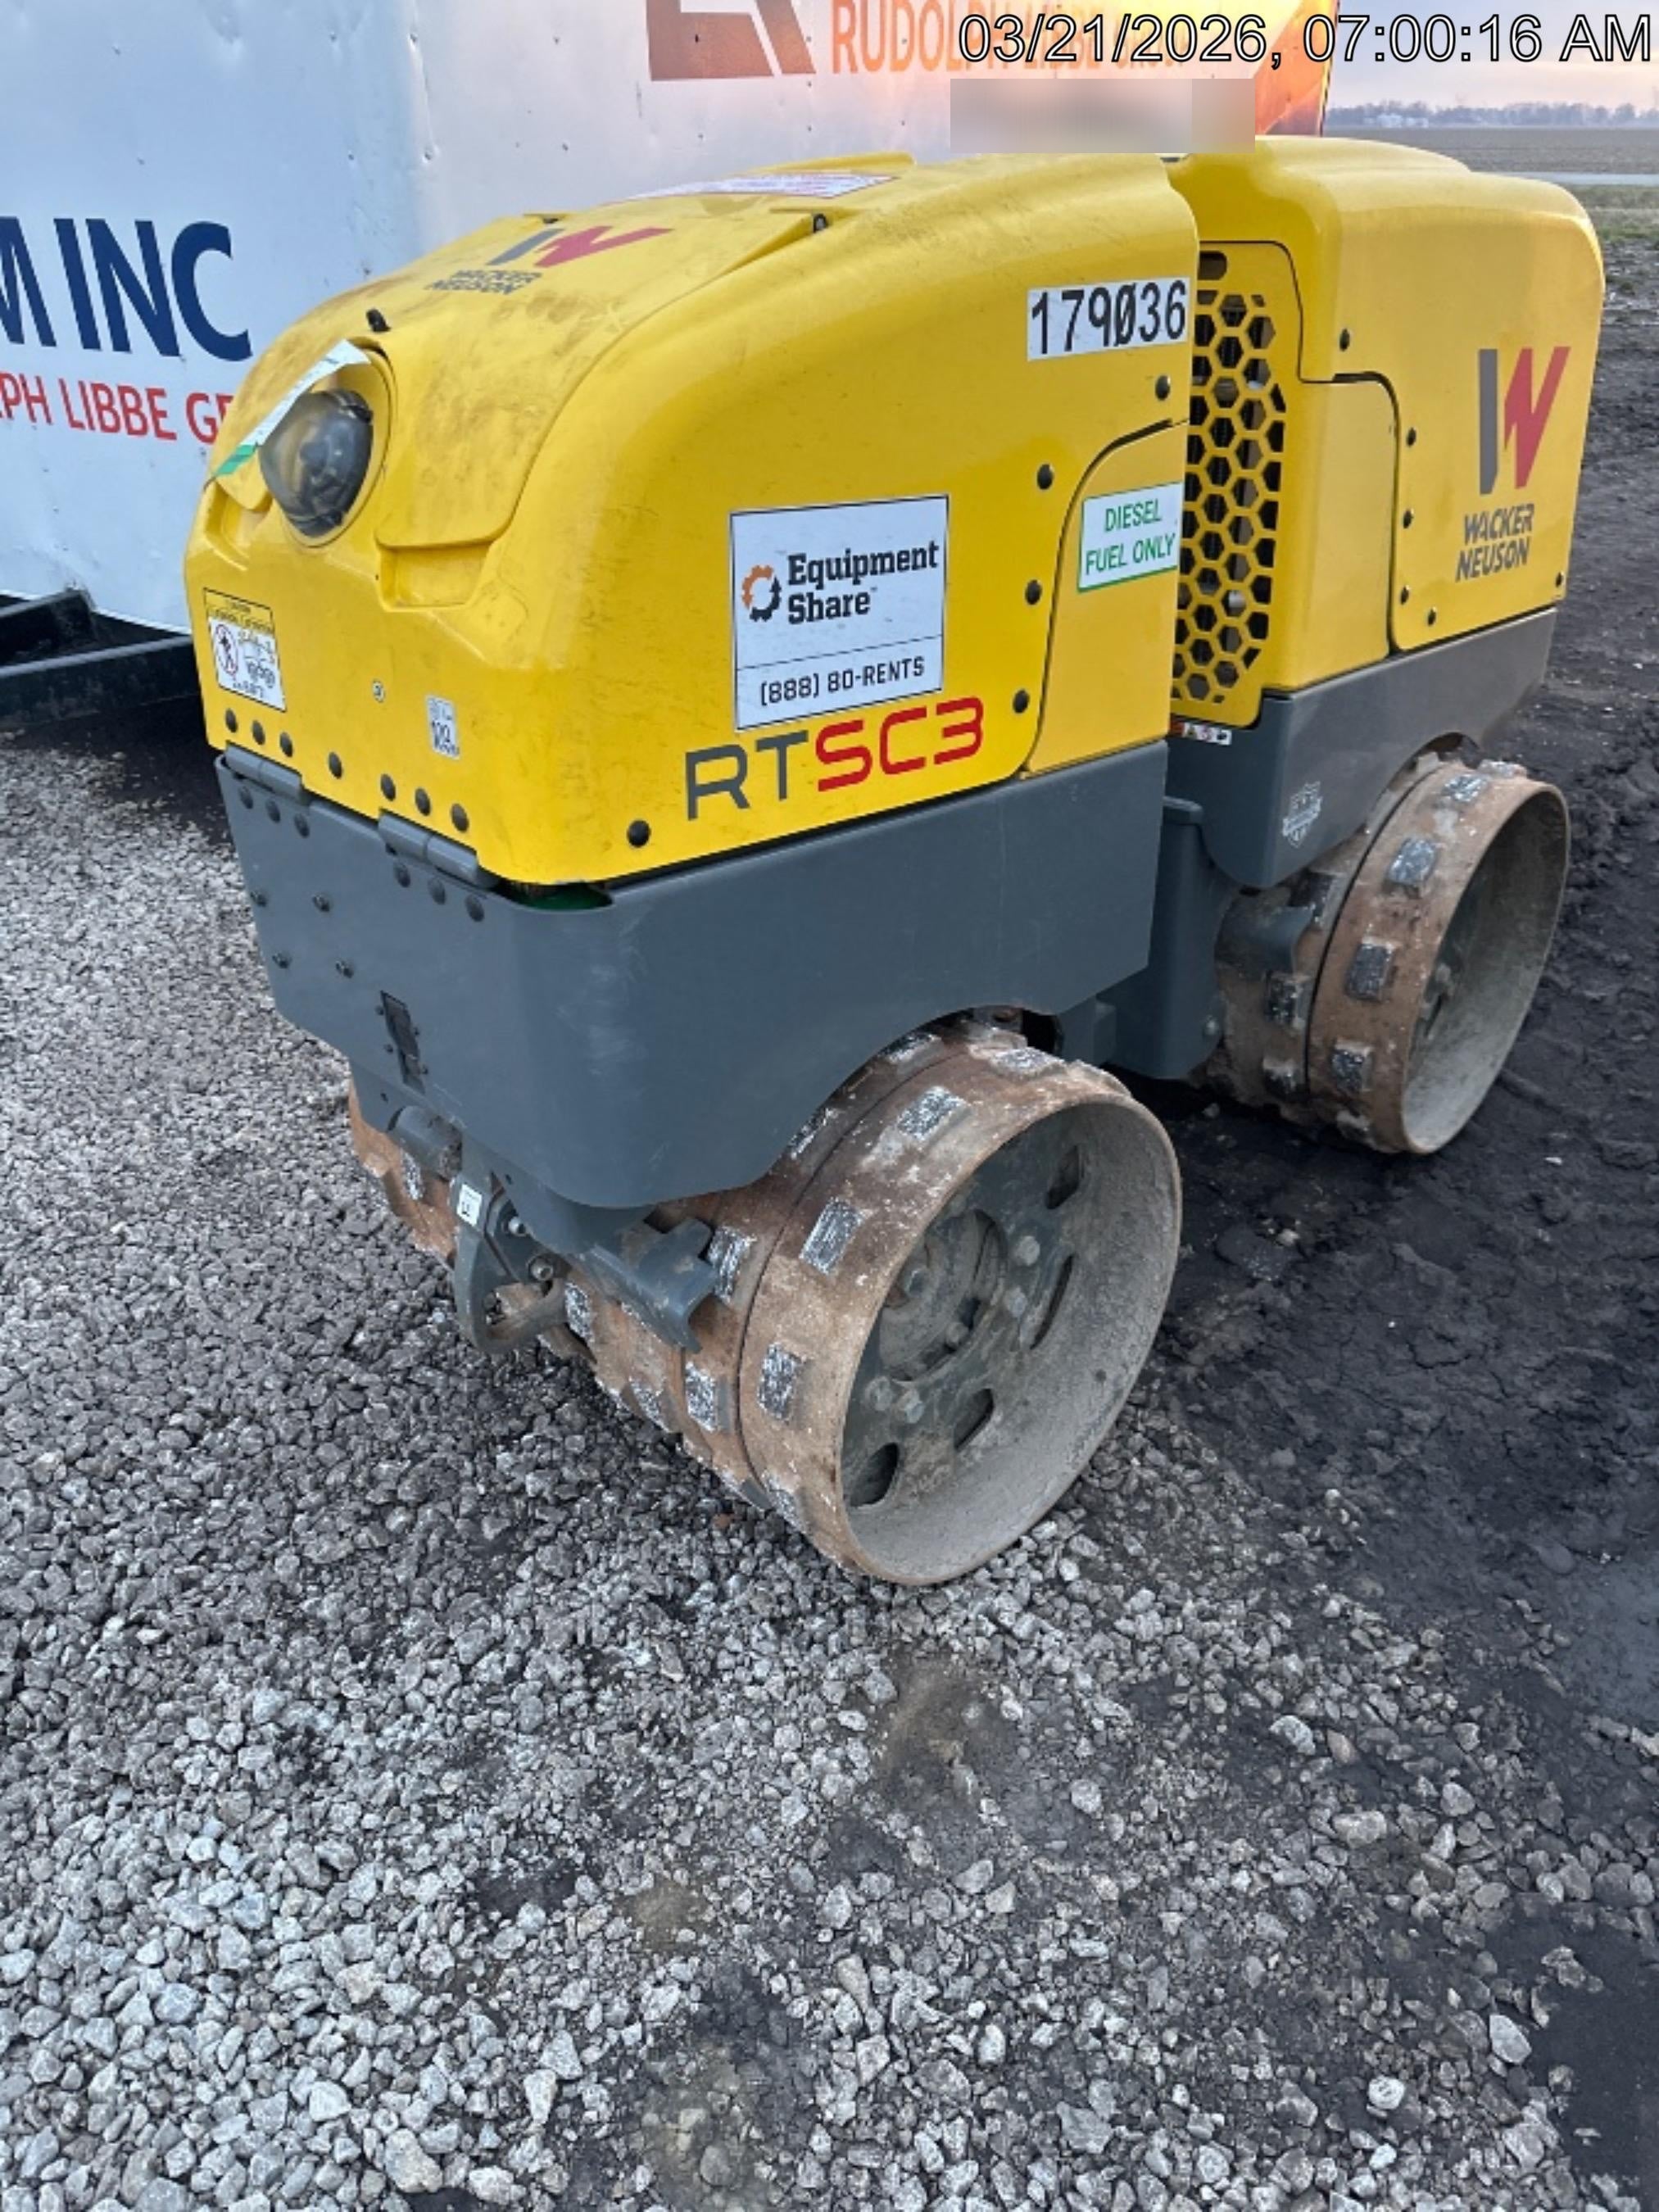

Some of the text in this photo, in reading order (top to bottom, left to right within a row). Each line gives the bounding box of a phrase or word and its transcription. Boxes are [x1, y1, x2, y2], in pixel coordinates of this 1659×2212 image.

[53, 218, 253, 361] INC
[59, 378, 177, 441] LIBBE
[1104, 497, 1162, 532] DIESEL
[1464, 503, 1534, 546] WACKER
[788, 540, 940, 590] Equipment
[1086, 533, 1176, 575] FUEL ONLY
[1455, 537, 1530, 583] NEUSON
[788, 591, 871, 625] Share
[760, 655, 925, 706] (888) 80-RENTS
[685, 696, 984, 821] RTSC3
